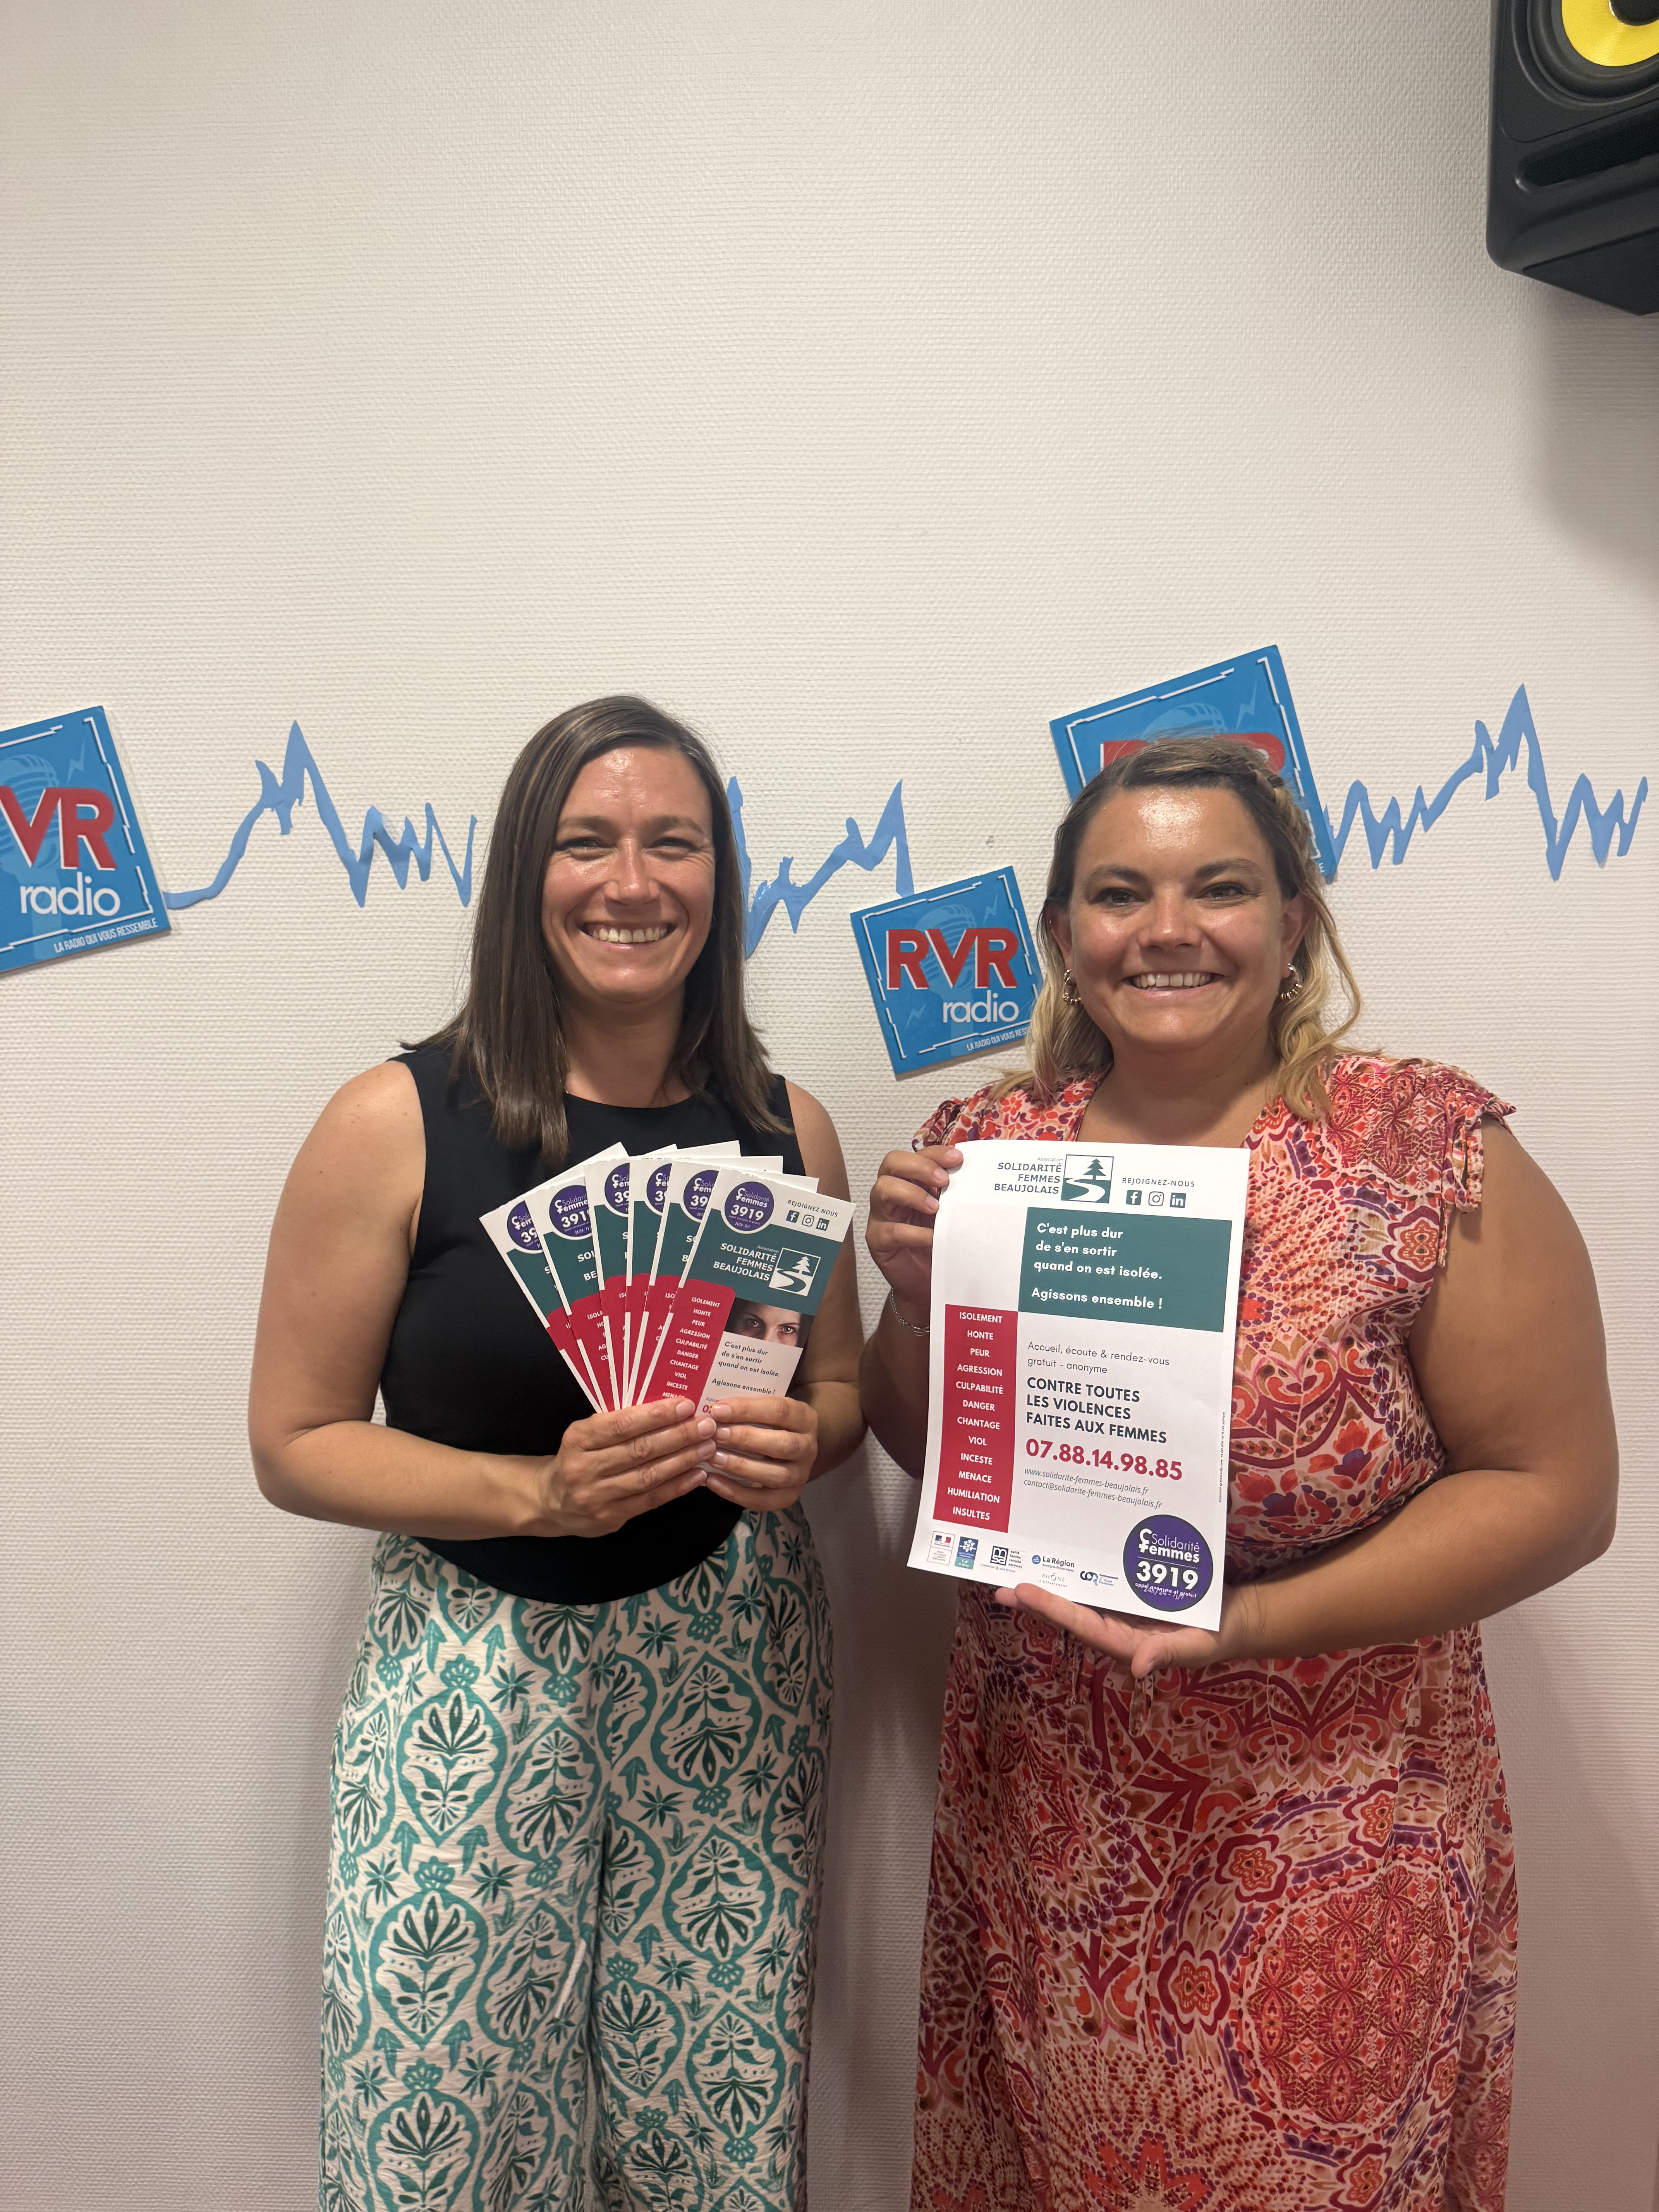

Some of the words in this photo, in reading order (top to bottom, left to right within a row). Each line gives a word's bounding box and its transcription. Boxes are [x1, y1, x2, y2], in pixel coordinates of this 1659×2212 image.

[0, 786, 117, 870] VR
[20, 872, 120, 916] radio
[54, 942, 64, 953] LA
[64, 936, 85, 950] RADIO
[85, 934, 98, 945] QUI
[98, 928, 117, 941] VOUS
[117, 918, 158, 936] RESSEMBLE
[886, 928, 1018, 990] RVR
[943, 990, 1018, 1023] radio
[974, 1039, 991, 1048] RADIO
[1001, 1031, 1015, 1041] VOUS
[998, 1163, 1062, 1172] SOLIDARITÉ
[1018, 1174, 1060, 1183] FEMMES
[1122, 1177, 1195, 1187] REJOIGNEZ-NOUS
[994, 1183, 1059, 1194] BEAUJOLAIS
[690, 1195, 708, 1207] 39
[744, 1191, 769, 1202] Solidarité
[731, 1204, 764, 1221] 3919
[788, 1200, 838, 1217] REJOIGNEZ-NOUS
[1037, 1223, 1067, 1235] C'est
[1071, 1226, 1097, 1239] plus
[1101, 1228, 1123, 1239] dur
[720, 1243, 776, 1262] SOLIDARITÉ
[1036, 1241, 1051, 1252] de
[1055, 1243, 1078, 1254] s'en
[1082, 1247, 1116, 1257] sortir
[713, 1261, 770, 1281] BEAUJOLAIS
[737, 1257, 773, 1272] FEMMES
[1034, 1261, 1073, 1273] quand
[1077, 1264, 1092, 1273] on
[1096, 1267, 1115, 1276] est
[1119, 1266, 1162, 1279] isolée.
[691, 1297, 720, 1307] ISOLEMENT
[1031, 1288, 1087, 1302] Agissons
[1092, 1295, 1154, 1309] ensemble
[1158, 1298, 1162, 1309] !
[959, 1312, 1003, 1323] ISOLEMENT
[680, 1328, 710, 1339] AGRESSION
[967, 1331, 993, 1340] HONTE
[676, 1338, 708, 1350] CULPABILITÉ
[725, 1341, 741, 1350] C'est
[677, 1350, 698, 1359] DANGER
[970, 1348, 989, 1357] PEUR
[1028, 1341, 1063, 1354] Accueil,
[1066, 1346, 1097, 1358] écoute
[1101, 1350, 1107, 1358] &
[1111, 1352, 1170, 1365] rendez-vous
[670, 1359, 699, 1370] CHANTAGE
[957, 1364, 1003, 1377] AGRESSION
[1027, 1358, 1056, 1368] gratuit
[1066, 1363, 1108, 1374] anonyme
[666, 1381, 688, 1390] INCESTE
[712, 1378, 741, 1388] Agissons
[742, 1385, 771, 1394] ensemble
[956, 1381, 1003, 1395] CULPABILITÉ
[1027, 1377, 1082, 1395] CONTRE
[1086, 1384, 1140, 1402] TOUTES
[963, 1400, 995, 1411] DANGER
[1027, 1395, 1049, 1408] LES
[1053, 1398, 1131, 1420] VIOLENCES
[957, 1417, 1000, 1430] CHANTAGE
[1026, 1412, 1071, 1429] FAITES
[1074, 1420, 1105, 1435] AUX
[1109, 1424, 1167, 1444] FEMMES
[969, 1436, 987, 1446] VIOL
[961, 1453, 993, 1465] INCESTE
[1026, 1438, 1182, 1481] 07.88.14.98.85
[958, 1471, 992, 1483] MENACE
[1024, 1468, 1149, 1495] www.solidarite-femmes-beaujolais.fr
[948, 1487, 1000, 1503] HUMILIATION
[1024, 1479, 1162, 1510] contact@solidarite-femmes-beaujolais.fr
[953, 1506, 990, 1520] INSULTES
[1151, 1533, 1200, 1553] Solidarité
[1051, 1558, 1075, 1568] Région
[1042, 1573, 1065, 1582] RHÔNE
[1136, 1561, 1199, 1590] 3919
